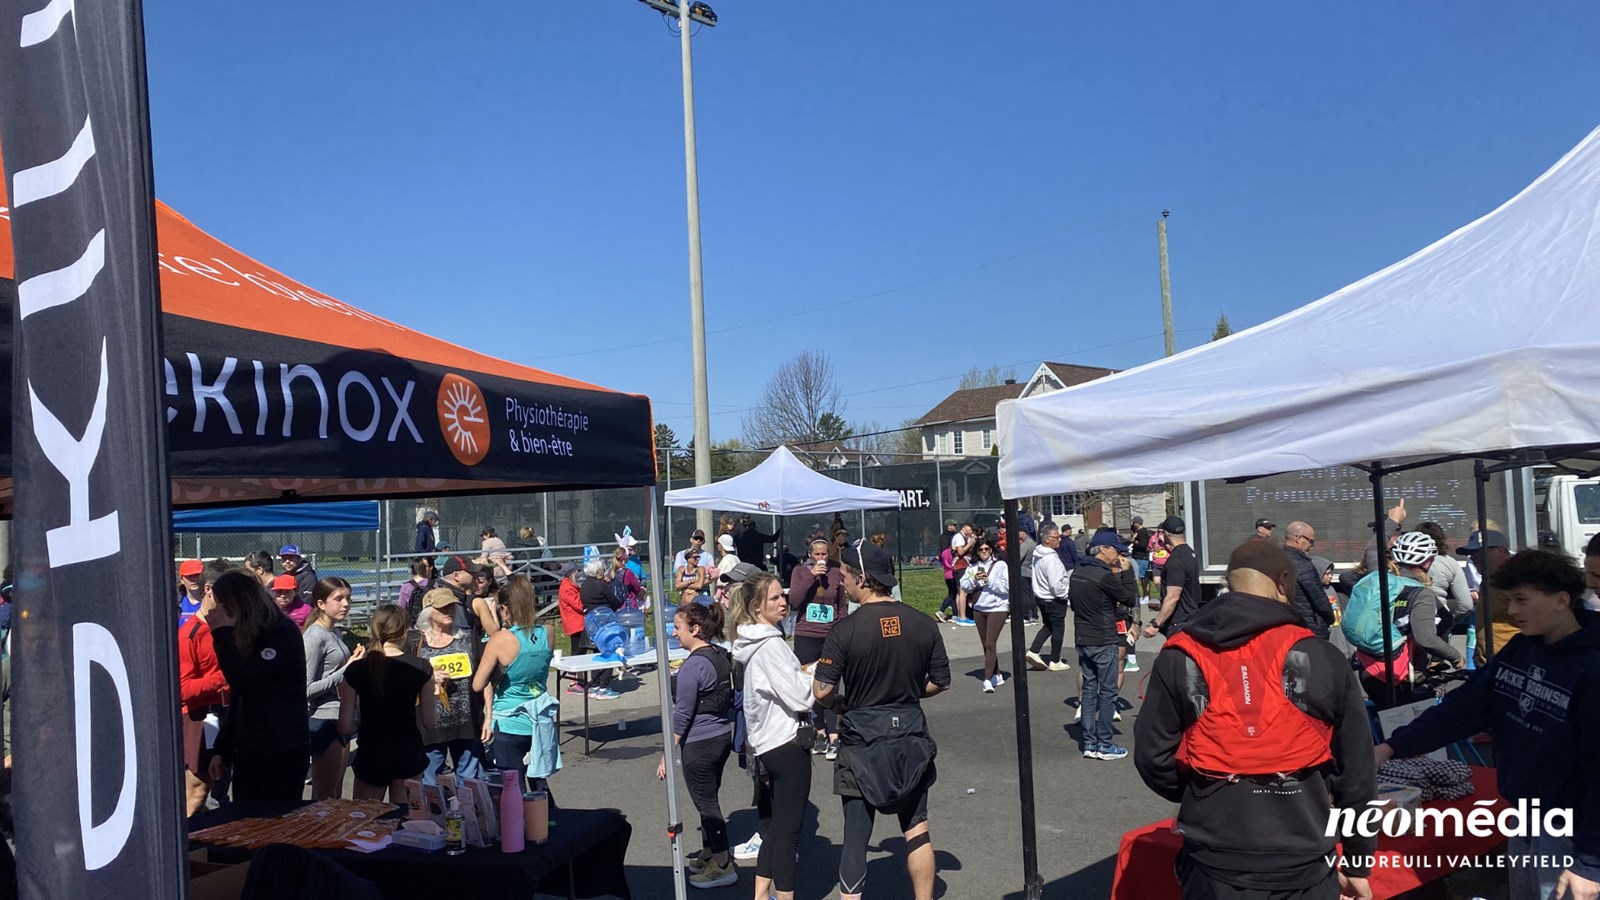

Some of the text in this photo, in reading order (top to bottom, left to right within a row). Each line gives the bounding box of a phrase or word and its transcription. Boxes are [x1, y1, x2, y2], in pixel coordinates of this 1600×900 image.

[505, 397, 589, 435] Physiothérapie
[509, 429, 573, 457] & bien-être
[893, 489, 923, 508] ART
[811, 610, 828, 620] 574
[1241, 665, 1252, 705] SALOMON
